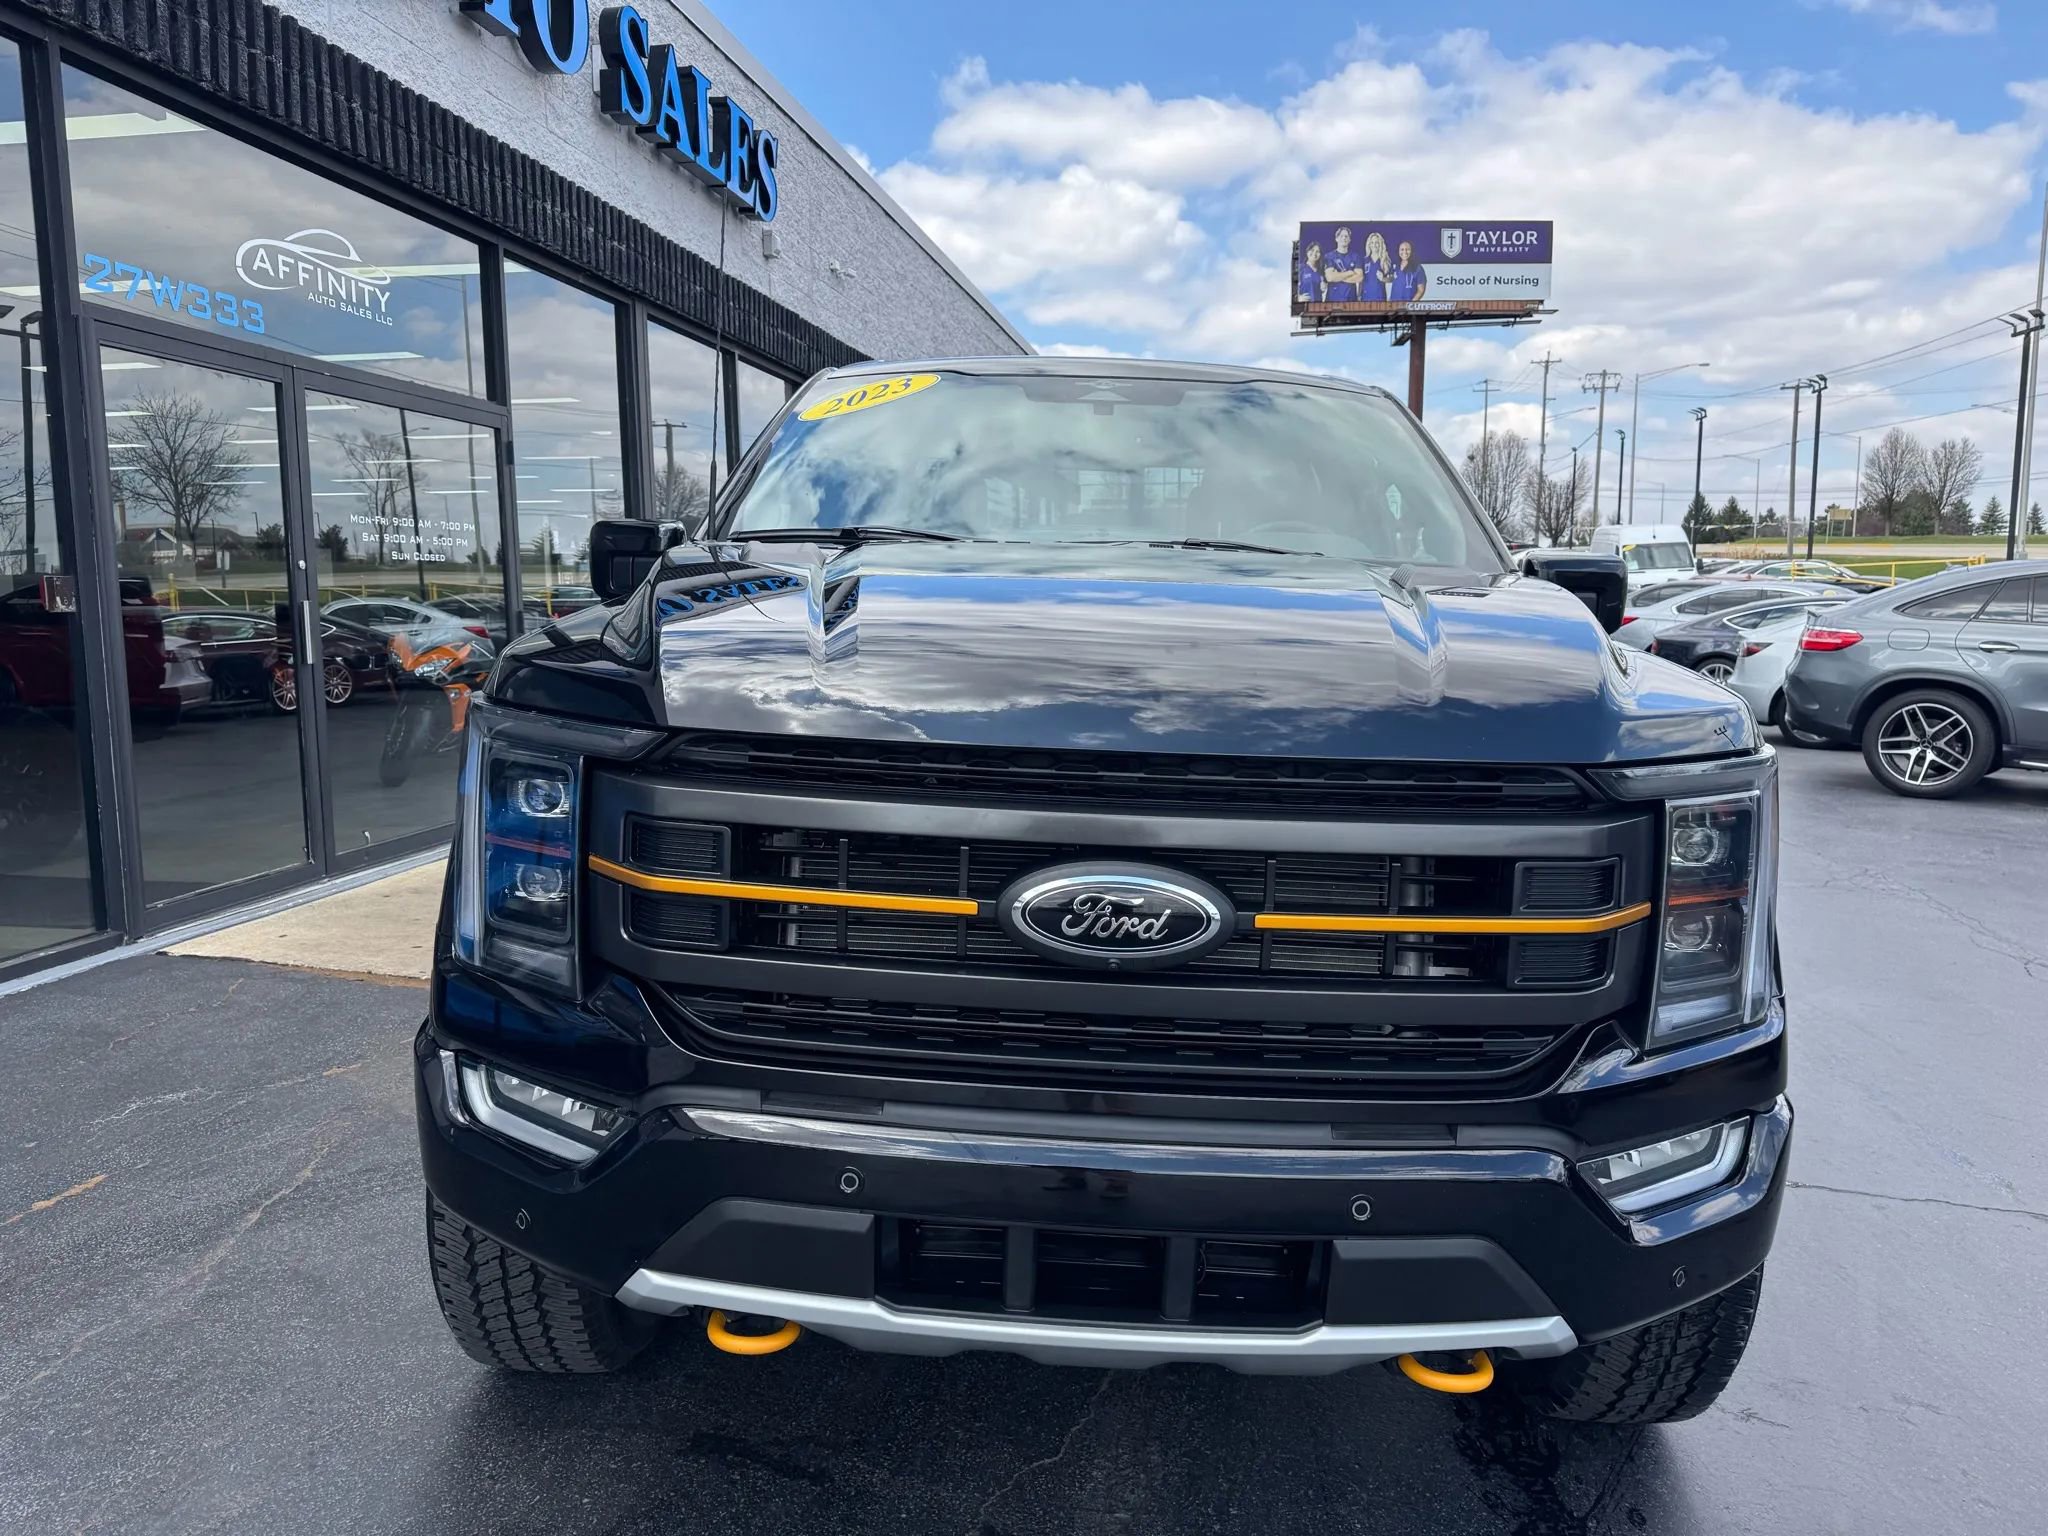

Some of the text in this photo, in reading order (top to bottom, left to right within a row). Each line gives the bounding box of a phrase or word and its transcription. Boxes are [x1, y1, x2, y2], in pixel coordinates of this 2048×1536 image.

[614, 5, 778, 222] SALES
[1466, 230, 1538, 245] TAYLOR
[84, 253, 265, 334] 27W333
[252, 247, 393, 312] AFFINITY
[1436, 275, 1539, 288] School of Nursing
[307, 291, 393, 326] AUTO SALES LLC
[823, 377, 913, 415] 2023
[383, 534, 406, 543] 9:00
[409, 536, 423, 544] AM
[433, 537, 453, 546] 5:00
[456, 538, 468, 547] PM
[392, 517, 415, 527] 9:00
[418, 519, 432, 528] AM
[440, 521, 461, 530] 7:00
[463, 523, 475, 532] PM
[1061, 893, 1172, 940] Ford
